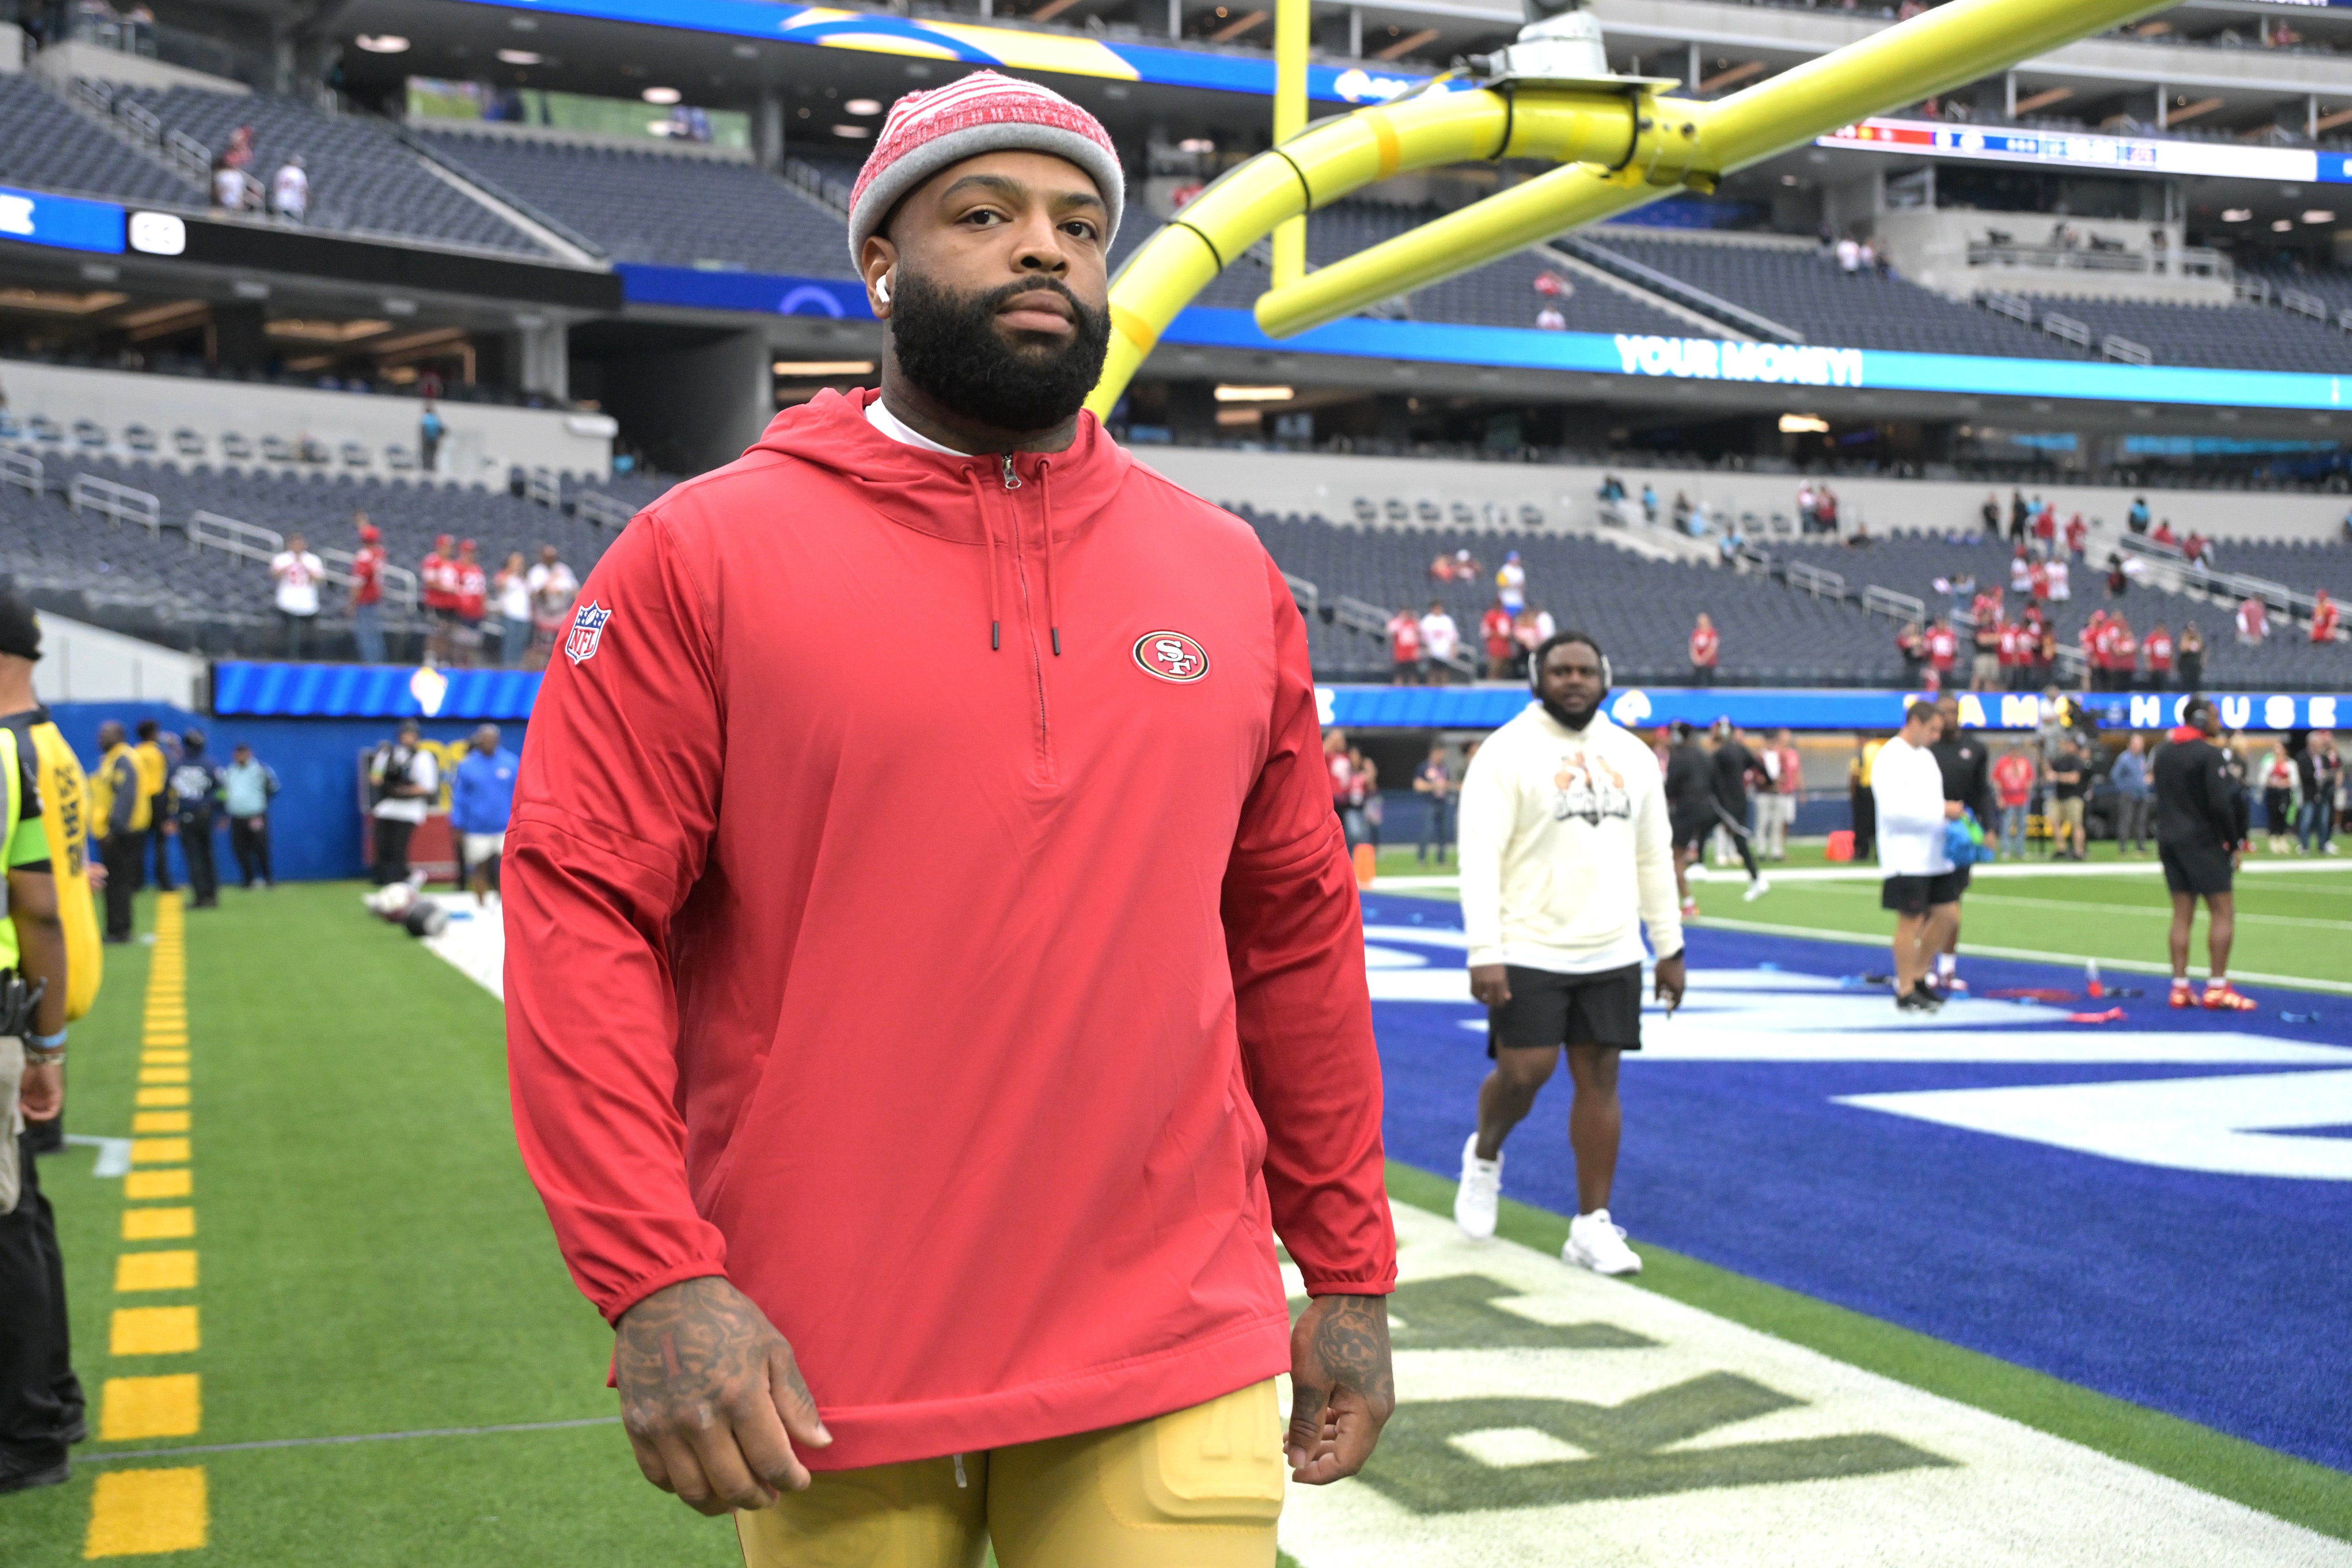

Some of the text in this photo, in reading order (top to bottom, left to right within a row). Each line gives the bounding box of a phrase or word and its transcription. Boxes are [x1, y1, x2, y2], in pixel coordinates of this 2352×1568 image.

[1614, 334, 1863, 387] YOUR MONEY!
[569, 627, 596, 656] NFL
[1155, 639, 1198, 675] SF
